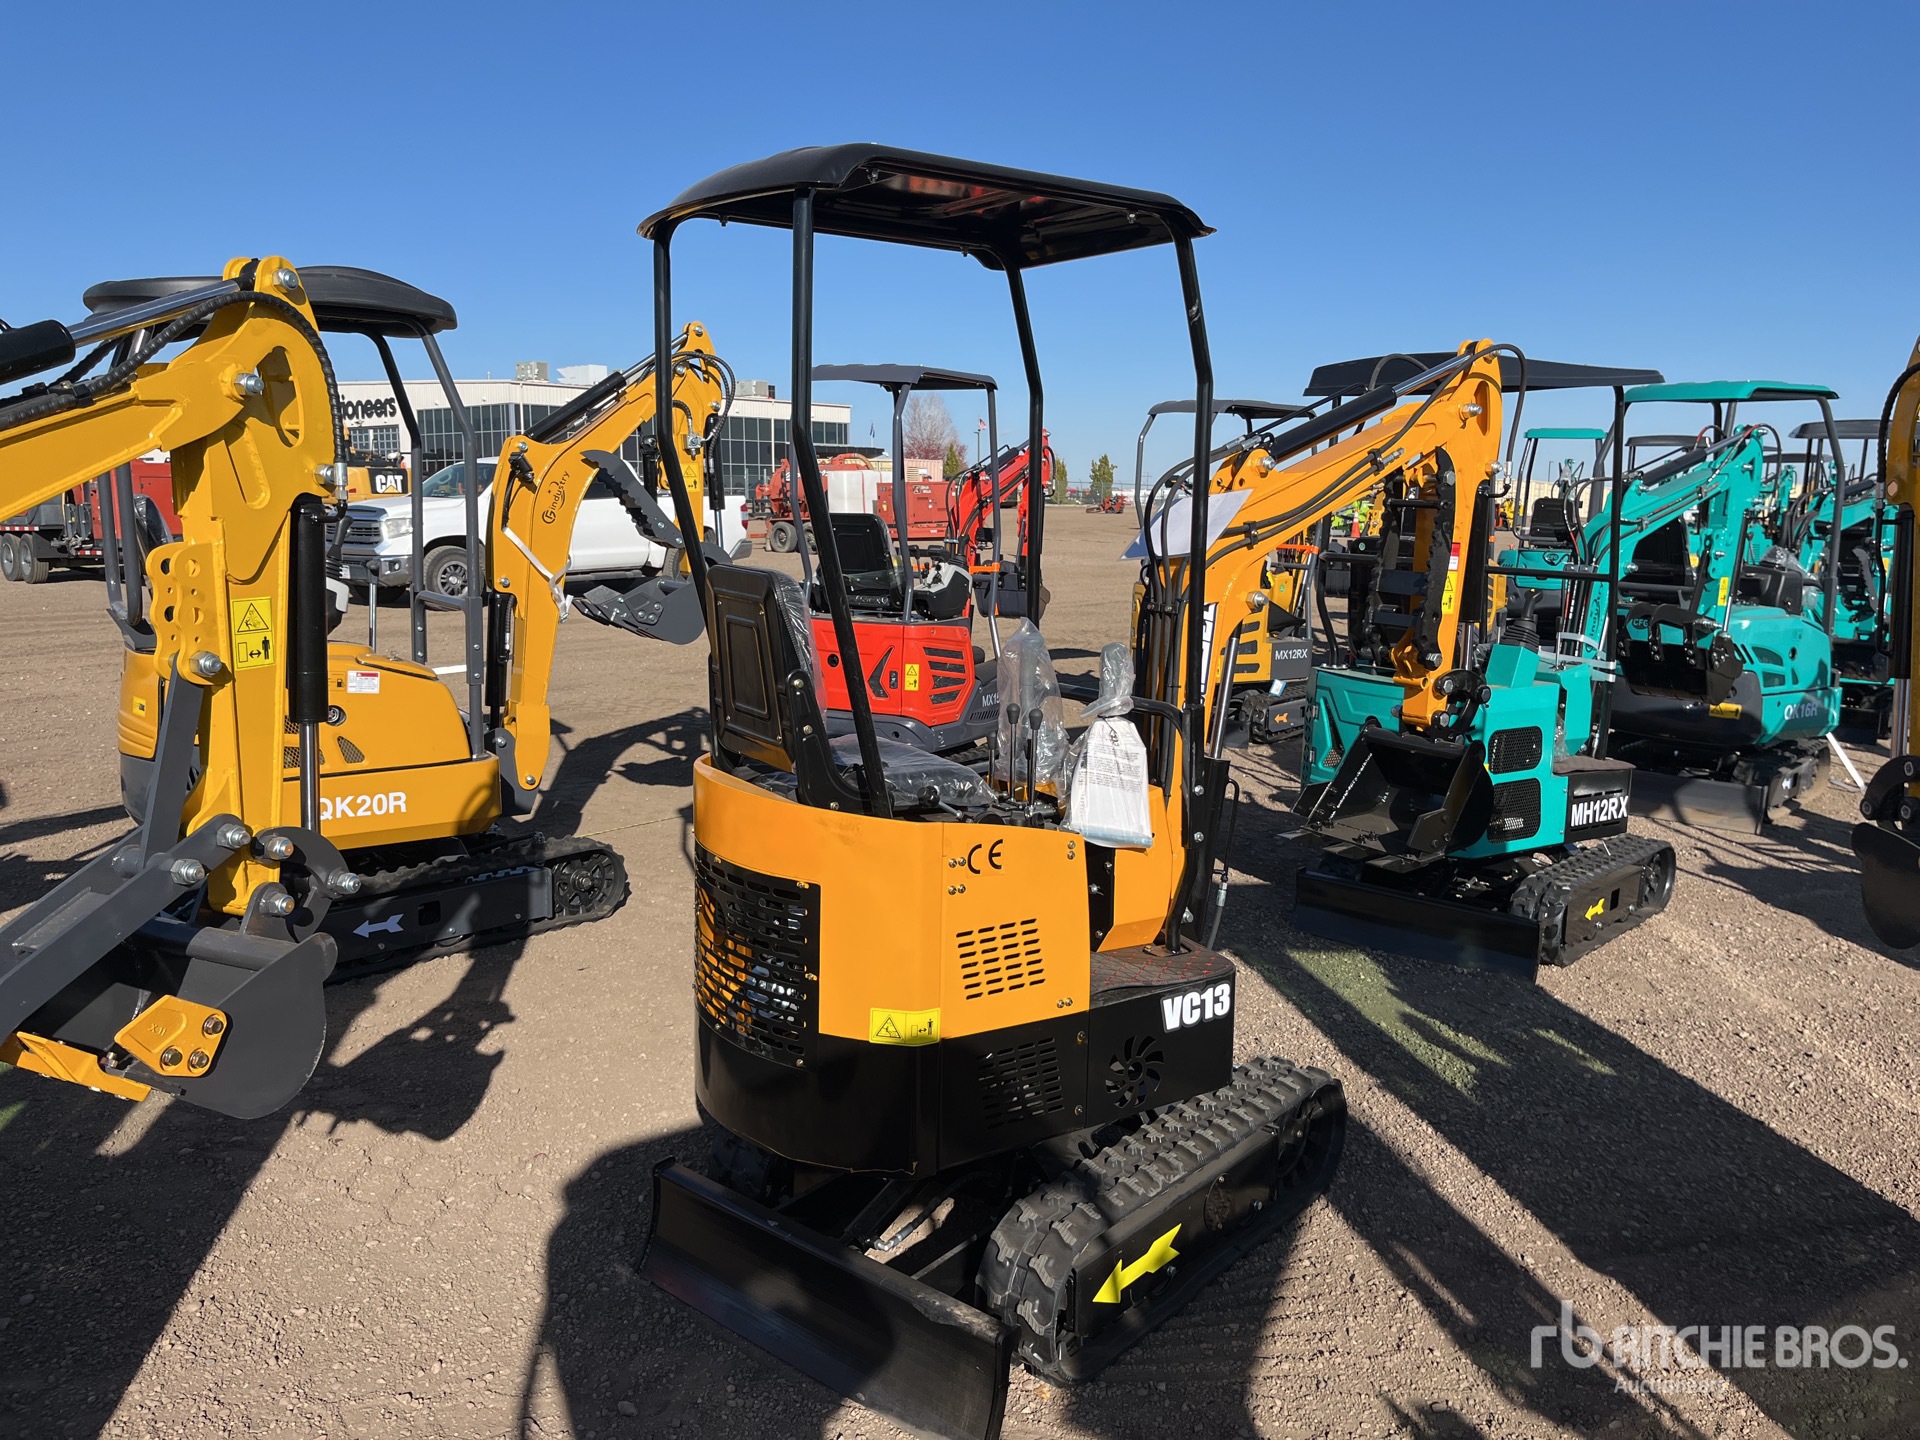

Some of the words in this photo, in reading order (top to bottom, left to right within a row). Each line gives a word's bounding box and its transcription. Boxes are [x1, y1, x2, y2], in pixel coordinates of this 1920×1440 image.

[340, 394, 396, 420] ioneers
[375, 474, 403, 493] CAT
[1633, 618, 1648, 628] CFG
[1275, 649, 1308, 660] MX12RX
[320, 792, 407, 820] QK20R
[1571, 795, 1629, 827] MH12RX
[967, 839, 1003, 875] CE
[1163, 983, 1231, 1030] VC13
